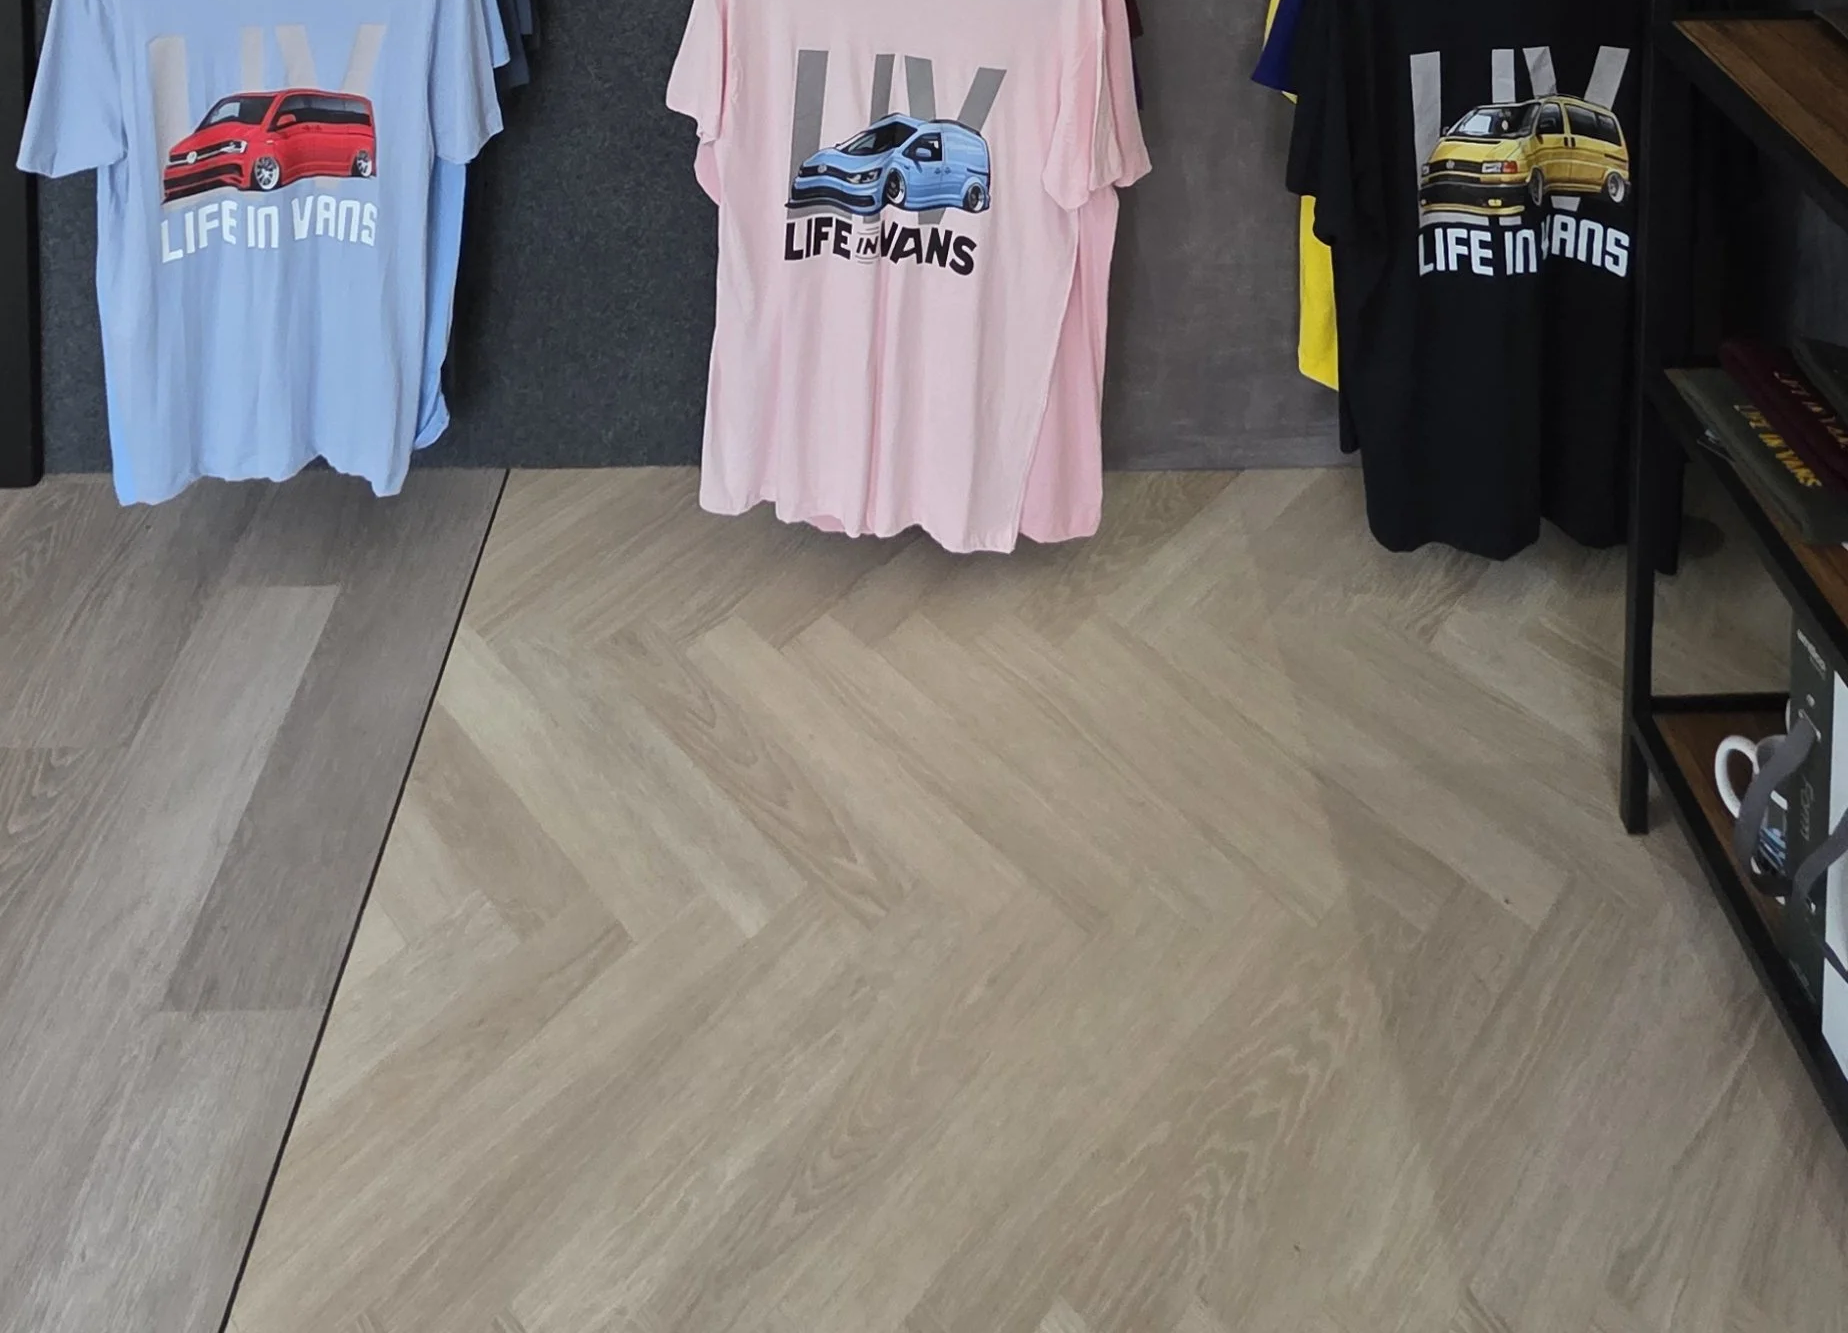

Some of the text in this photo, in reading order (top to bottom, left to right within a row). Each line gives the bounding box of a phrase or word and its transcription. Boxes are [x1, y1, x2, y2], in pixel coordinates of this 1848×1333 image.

[161, 195, 378, 263] LIFE IN VANS
[784, 216, 978, 276] LIFE IN VANS
[1418, 214, 1630, 278] LIFE IN VANS
